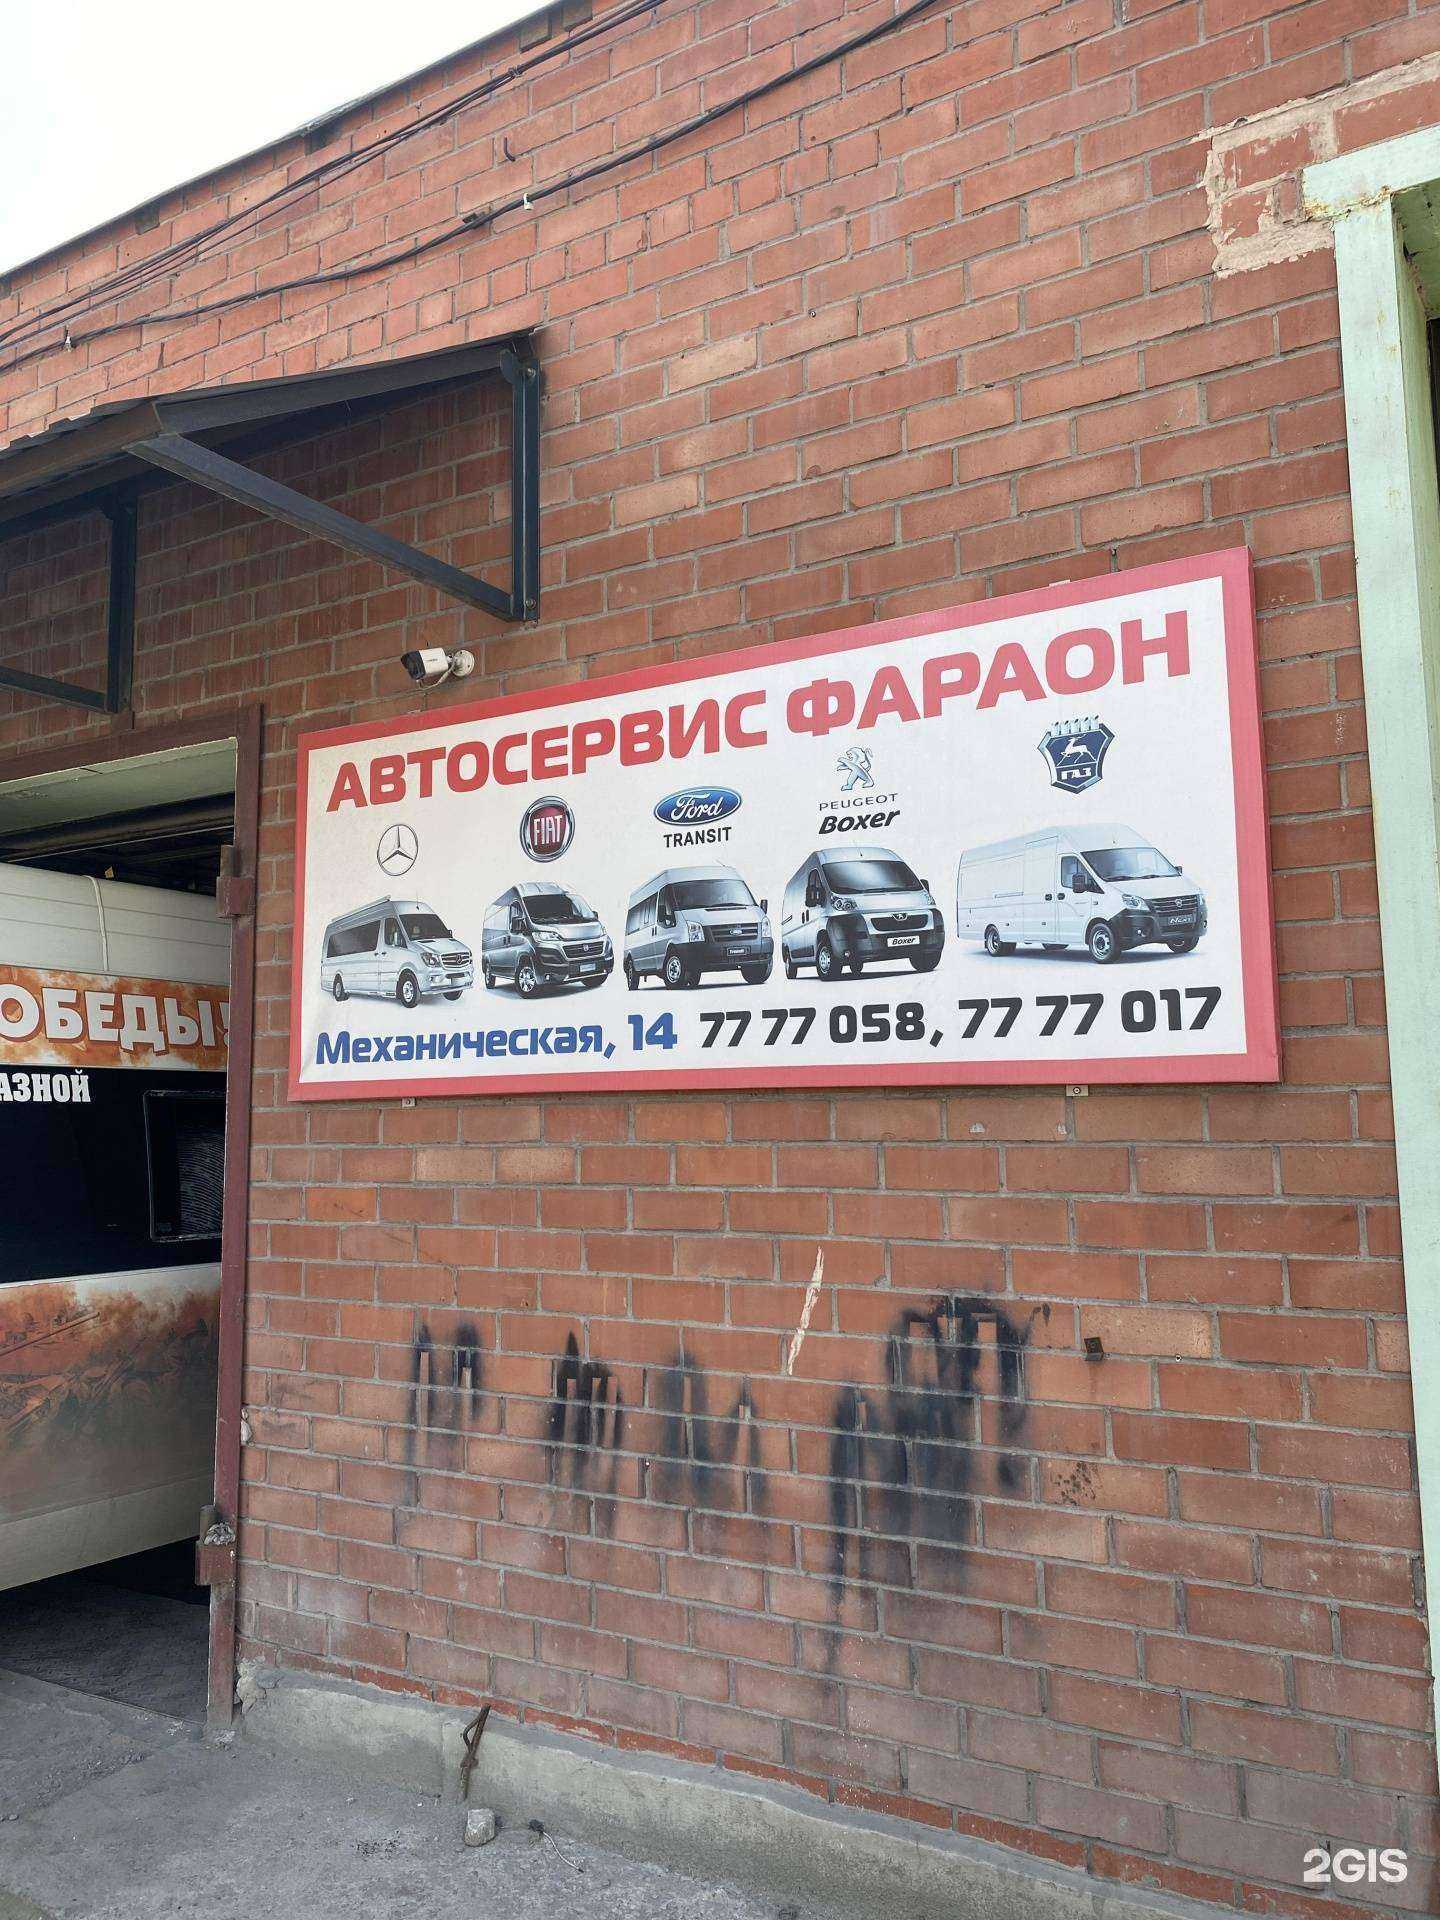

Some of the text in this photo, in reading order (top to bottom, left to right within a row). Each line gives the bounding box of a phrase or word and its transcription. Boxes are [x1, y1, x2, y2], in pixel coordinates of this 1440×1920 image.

[326, 609, 1191, 812] АВТОСЕРВИС ФАРАОН
[669, 793, 723, 822] Ford
[819, 793, 899, 811] PEUGEOT
[533, 814, 563, 846] FIAT
[663, 826, 733, 849] TRANSIT
[818, 810, 901, 835] Boxer
[699, 986, 1222, 1048] 77 77 058, 77 77 017
[316, 1012, 678, 1064] Механическая, 14
